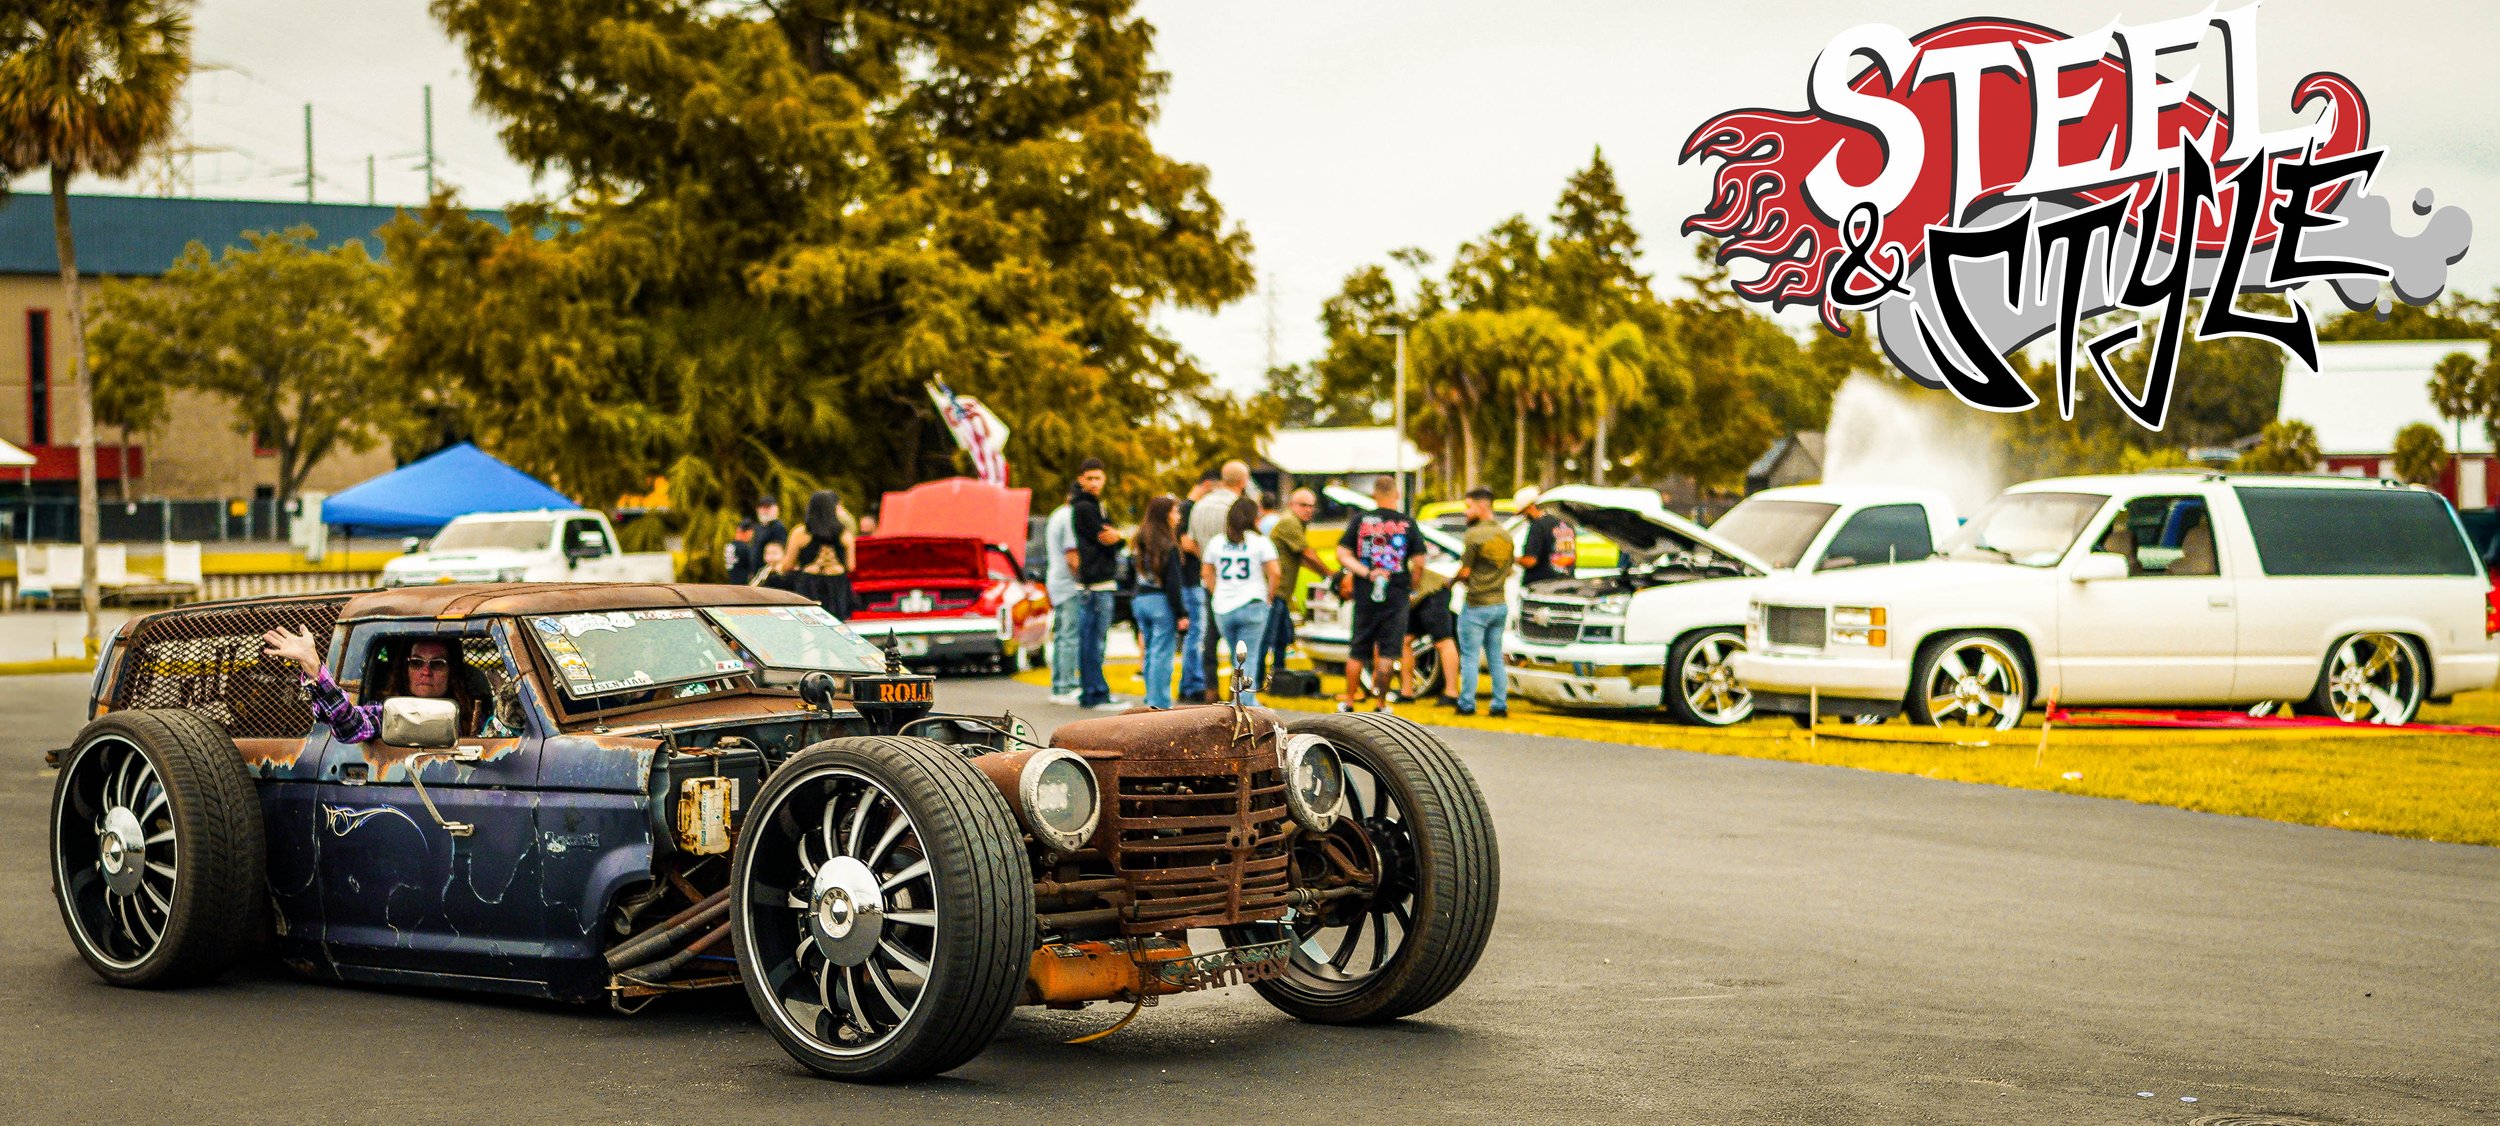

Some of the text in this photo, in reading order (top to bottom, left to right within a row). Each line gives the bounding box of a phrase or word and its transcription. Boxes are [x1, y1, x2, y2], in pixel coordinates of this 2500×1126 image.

[1220, 557, 1250, 579] 23
[823, 890, 849, 906] FORD
[1182, 956, 1291, 993] SHITBOX
